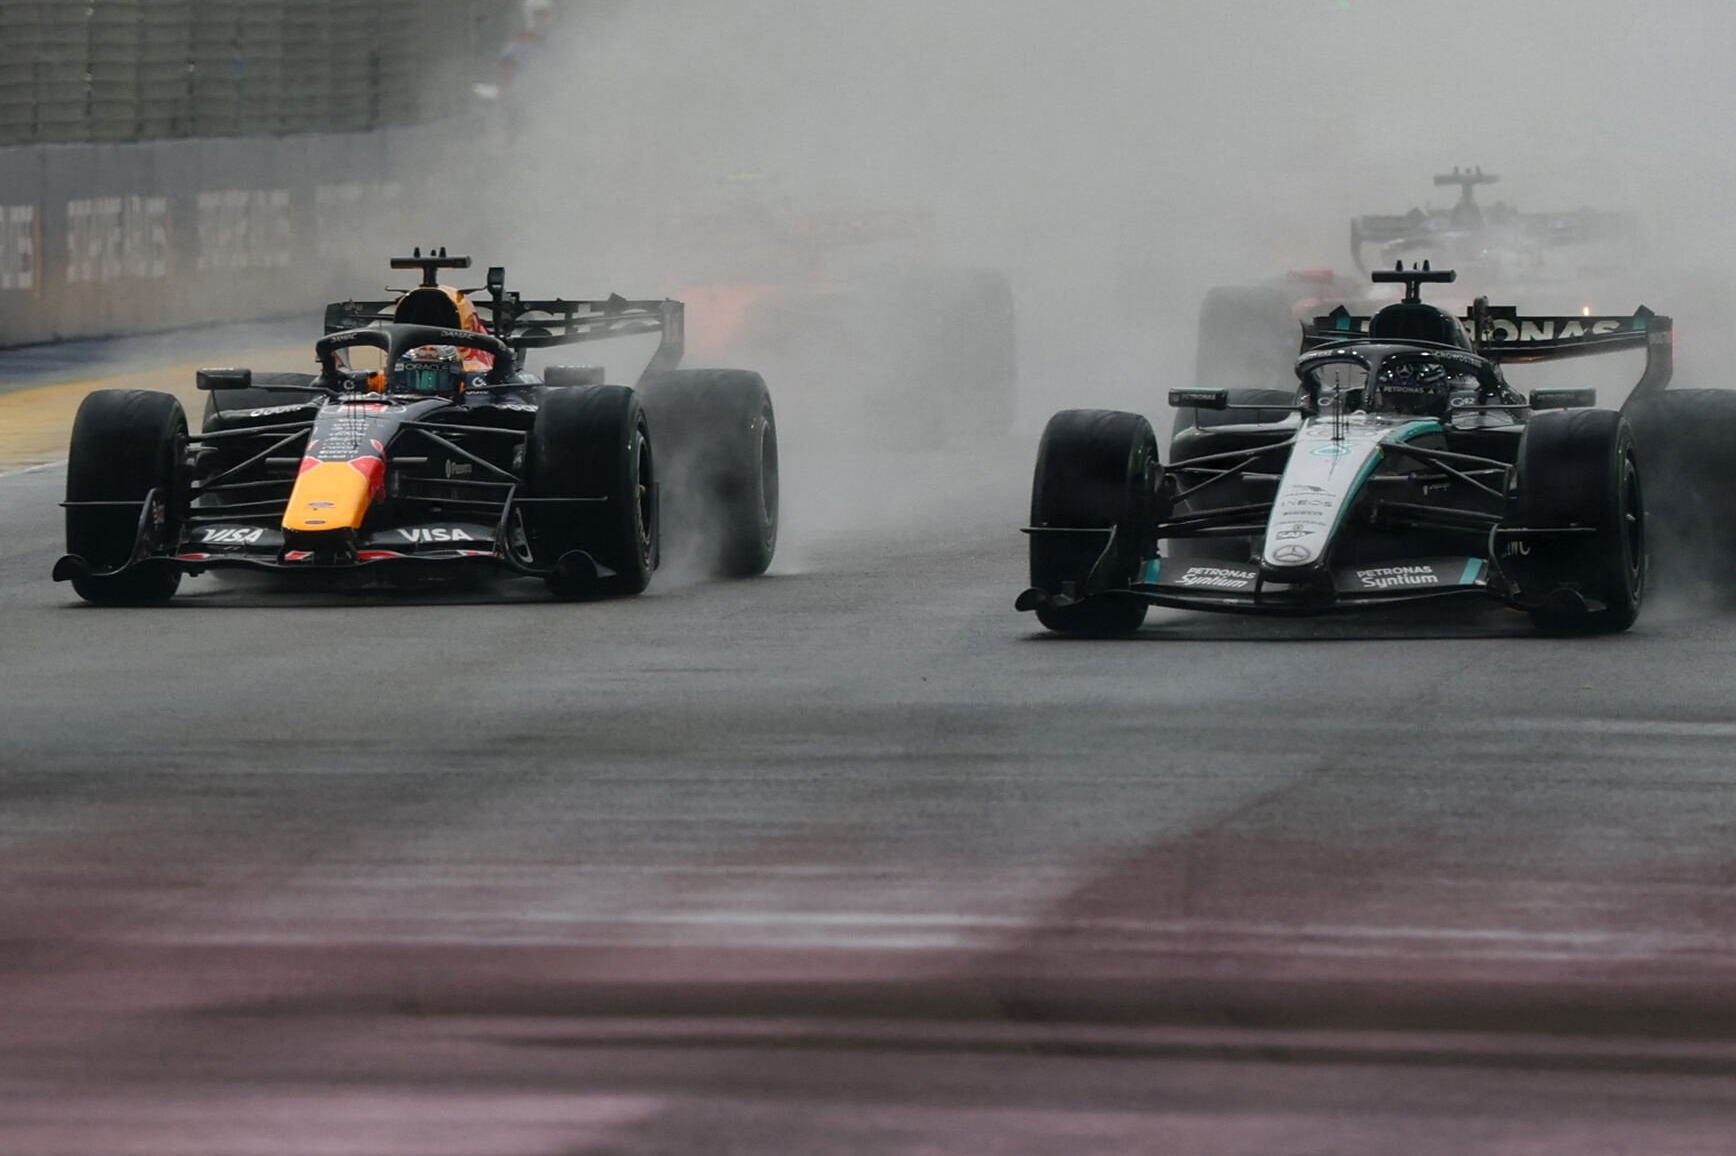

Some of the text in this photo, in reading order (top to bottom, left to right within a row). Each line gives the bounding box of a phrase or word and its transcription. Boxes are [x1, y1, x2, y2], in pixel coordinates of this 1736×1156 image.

[1383, 385, 1424, 393] PETRONAS
[202, 528, 264, 542] VISA
[397, 528, 474, 542] VISA
[1187, 567, 1256, 579] PETRONAS
[1357, 566, 1433, 577] PETRONAS
[1174, 573, 1248, 588] Syntium
[1360, 573, 1438, 588] Syntium
